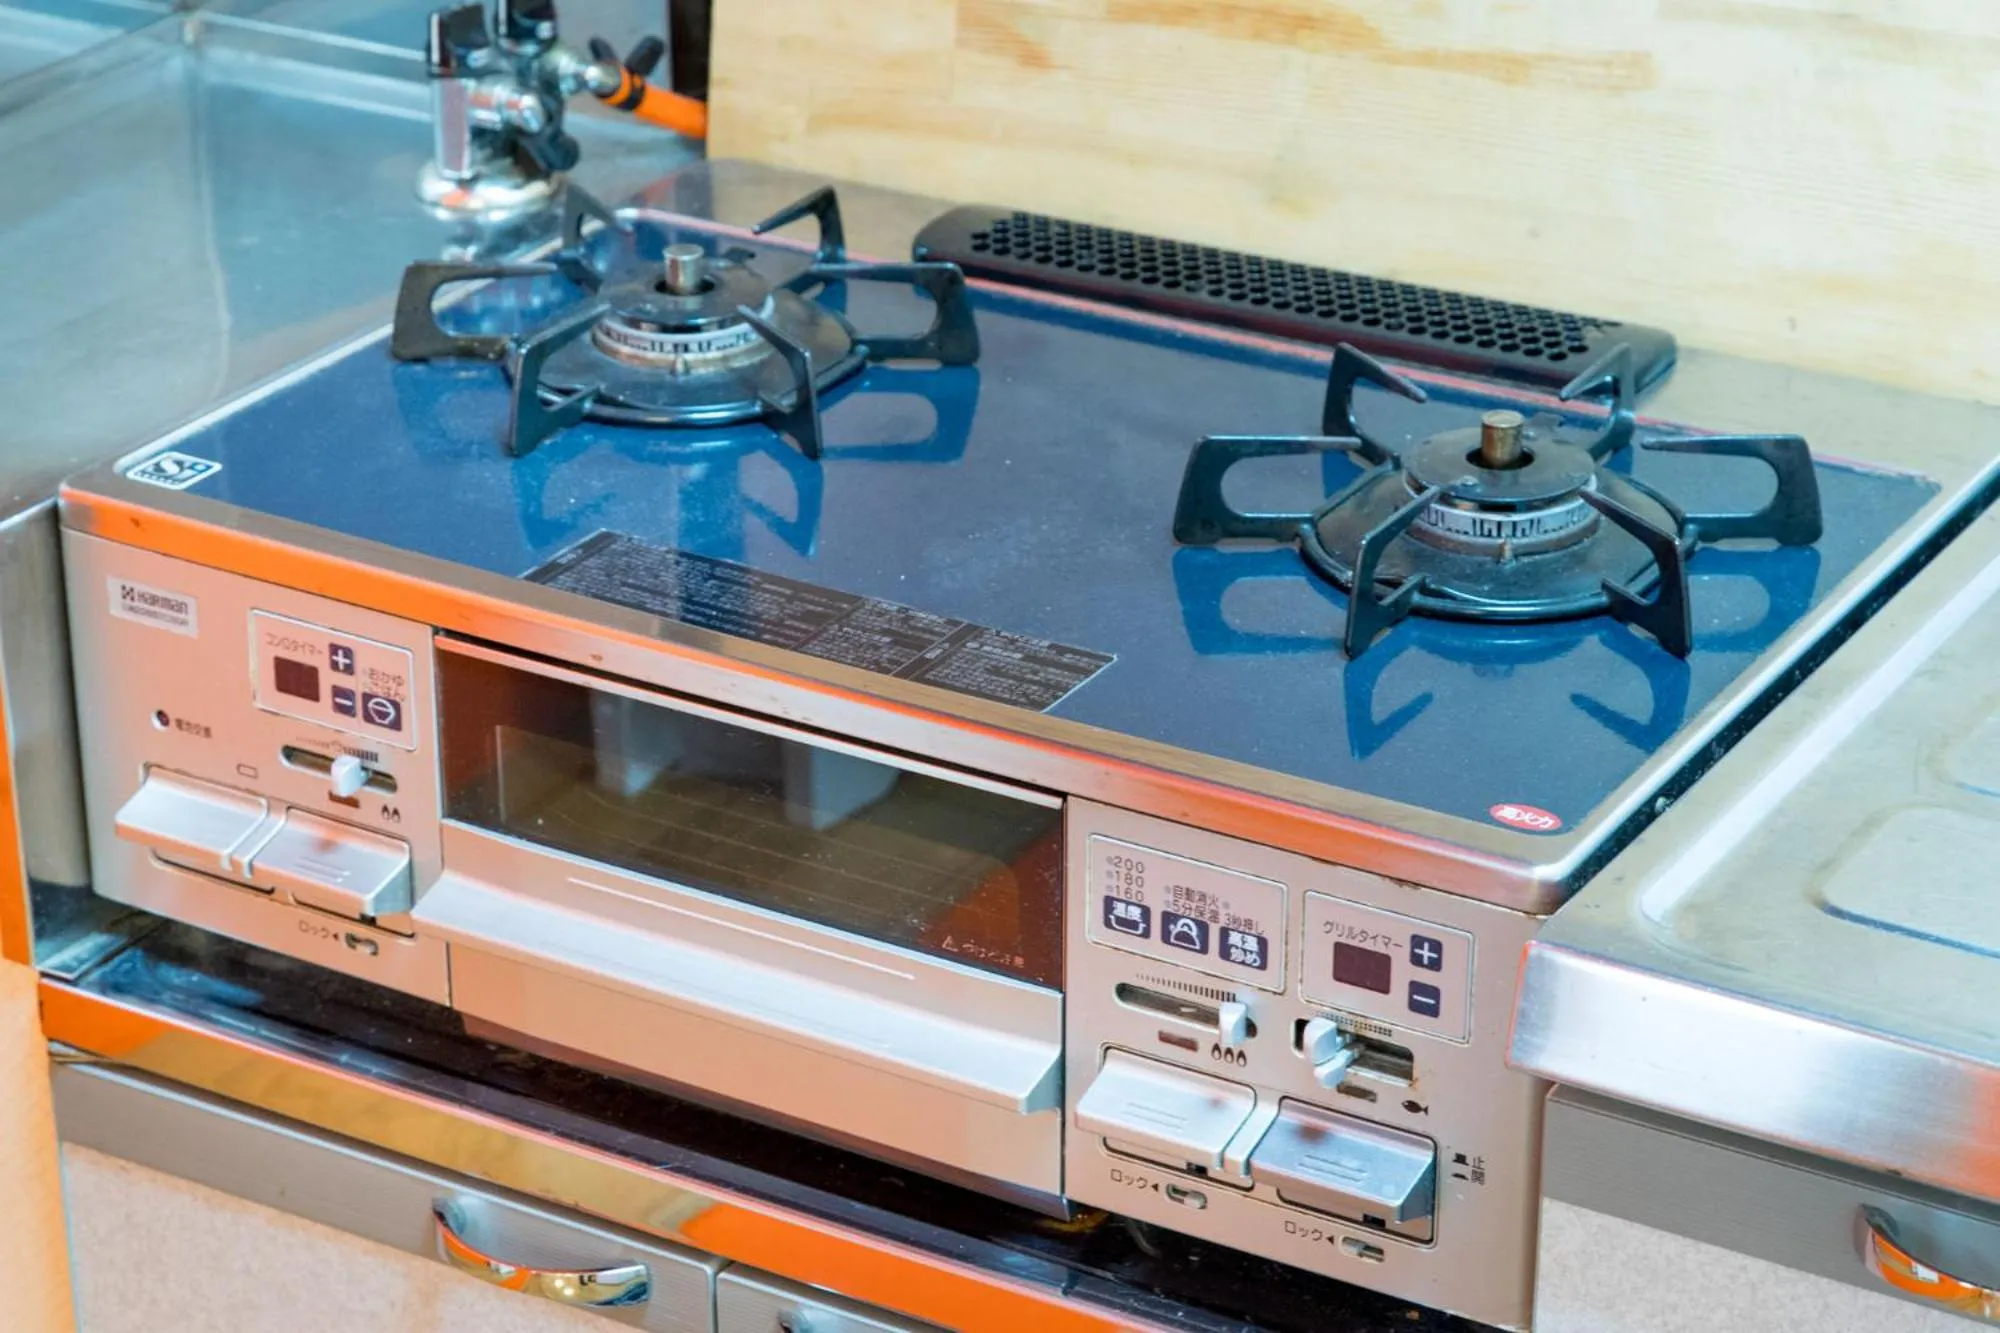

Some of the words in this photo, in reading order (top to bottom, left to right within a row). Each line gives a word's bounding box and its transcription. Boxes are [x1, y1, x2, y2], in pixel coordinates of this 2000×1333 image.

[1113, 856, 1145, 875] 200
[1114, 870, 1145, 889] 180
[1114, 885, 1145, 903] 160
[1172, 884, 1220, 910] 自動消火
[1323, 920, 1404, 949] グリルタイマー
[1110, 1168, 1148, 1189] ロック
[1284, 1220, 1323, 1241] ロック
